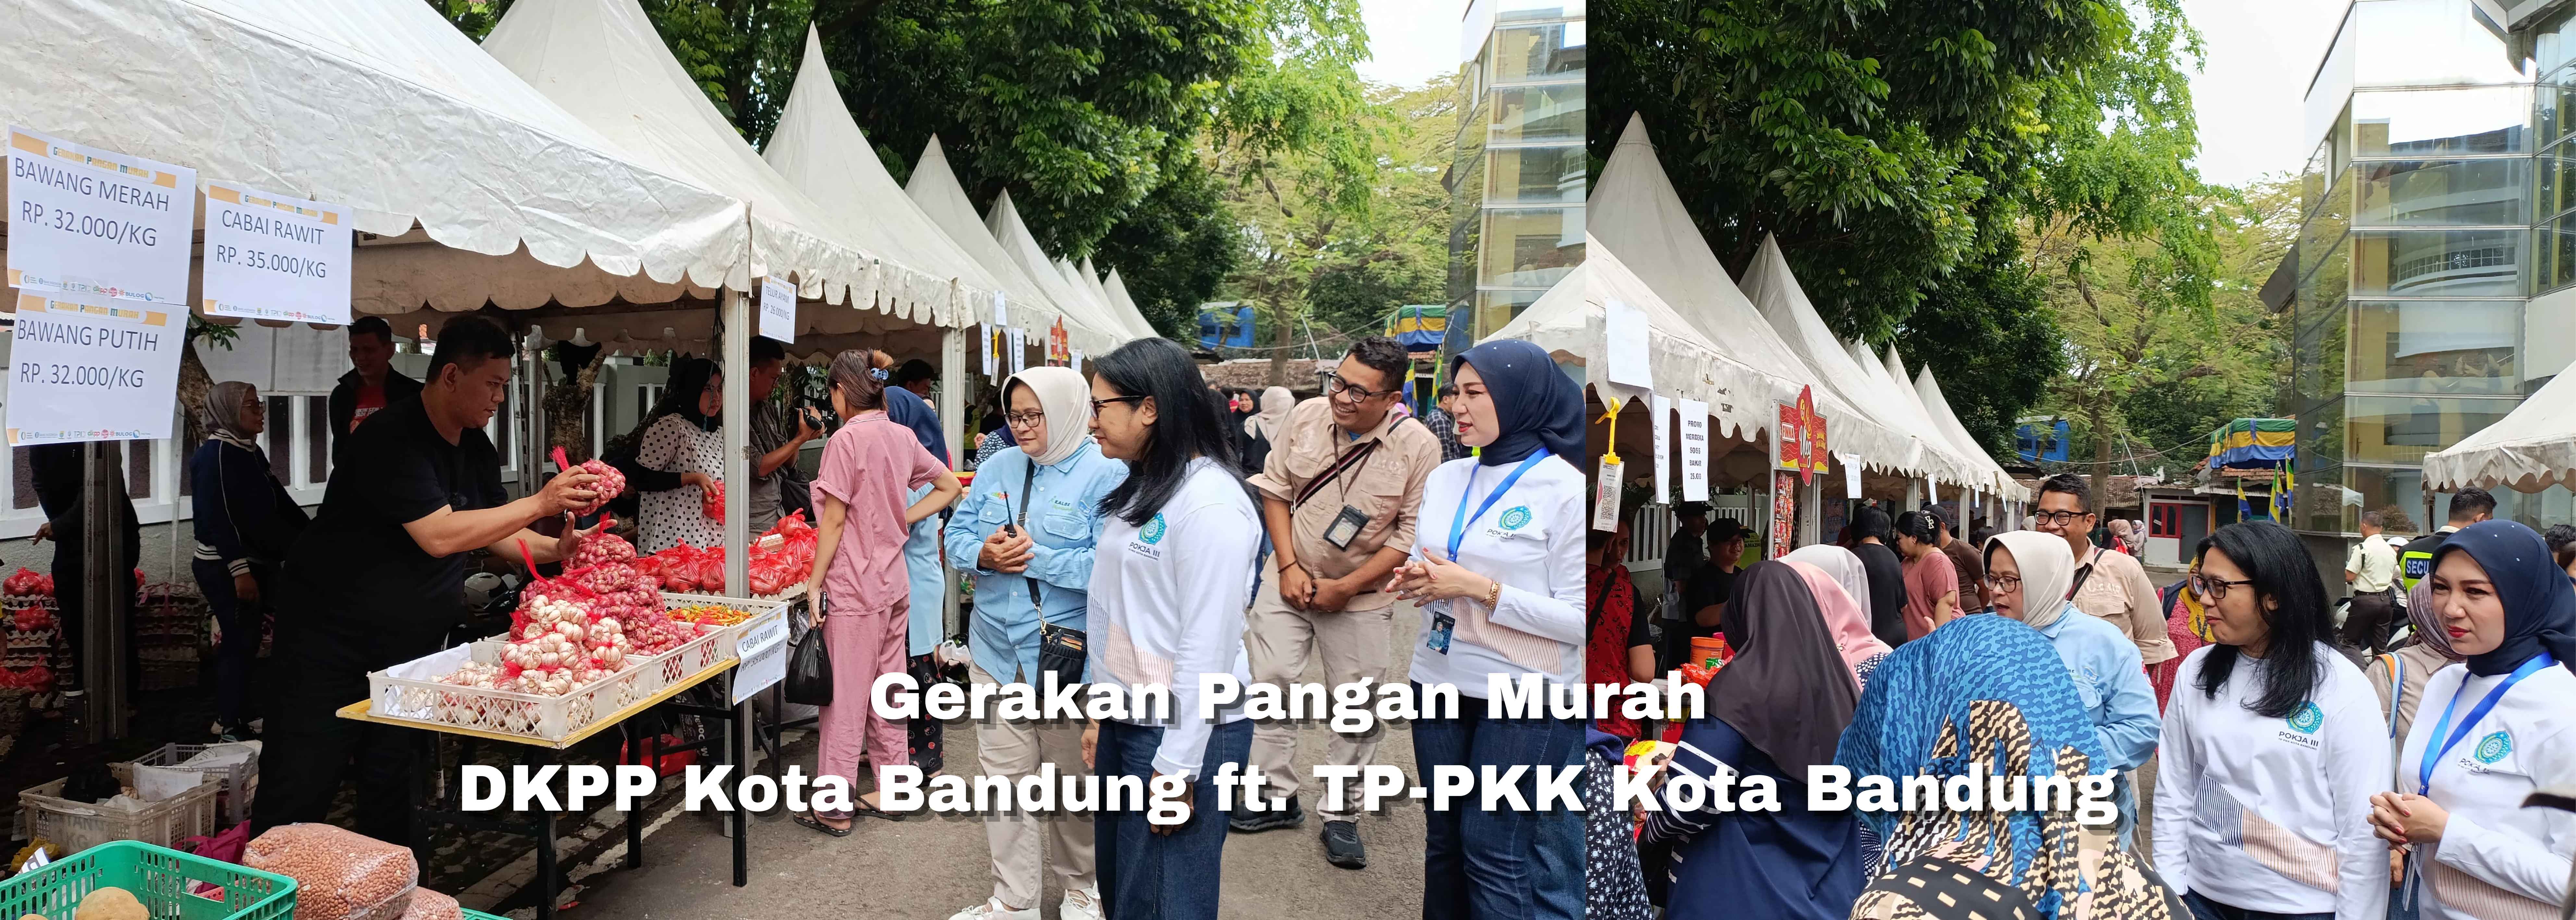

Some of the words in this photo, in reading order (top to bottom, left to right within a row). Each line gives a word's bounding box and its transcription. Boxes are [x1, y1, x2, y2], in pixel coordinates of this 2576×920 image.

[15, 157, 92, 195] BAWANG
[99, 180, 169, 212] MERAH
[23, 201, 47, 226] RP.
[54, 209, 156, 246] 32.000/KG
[222, 210, 268, 235] CABAI
[275, 221, 324, 245] RAWIT
[217, 245, 241, 265] RP.
[247, 250, 326, 278] 35.000/KG
[766, 286, 778, 299] TELUR
[778, 292, 789, 303] AYAM
[770, 305, 789, 320] 26.000/KG
[18, 319, 92, 346] BAWANG
[99, 328, 158, 351] PUTIH
[21, 362, 44, 383] RP.
[51, 364, 144, 390] 32.000/KG
[1686, 433, 1704, 441] MERDEKA
[1782, 426, 1794, 439] FINNA
[1129, 542, 1151, 555] POKJA
[742, 634, 759, 652] CABAI
[760, 625, 778, 644] RAWIT
[2279, 731, 2308, 744] POKJA
